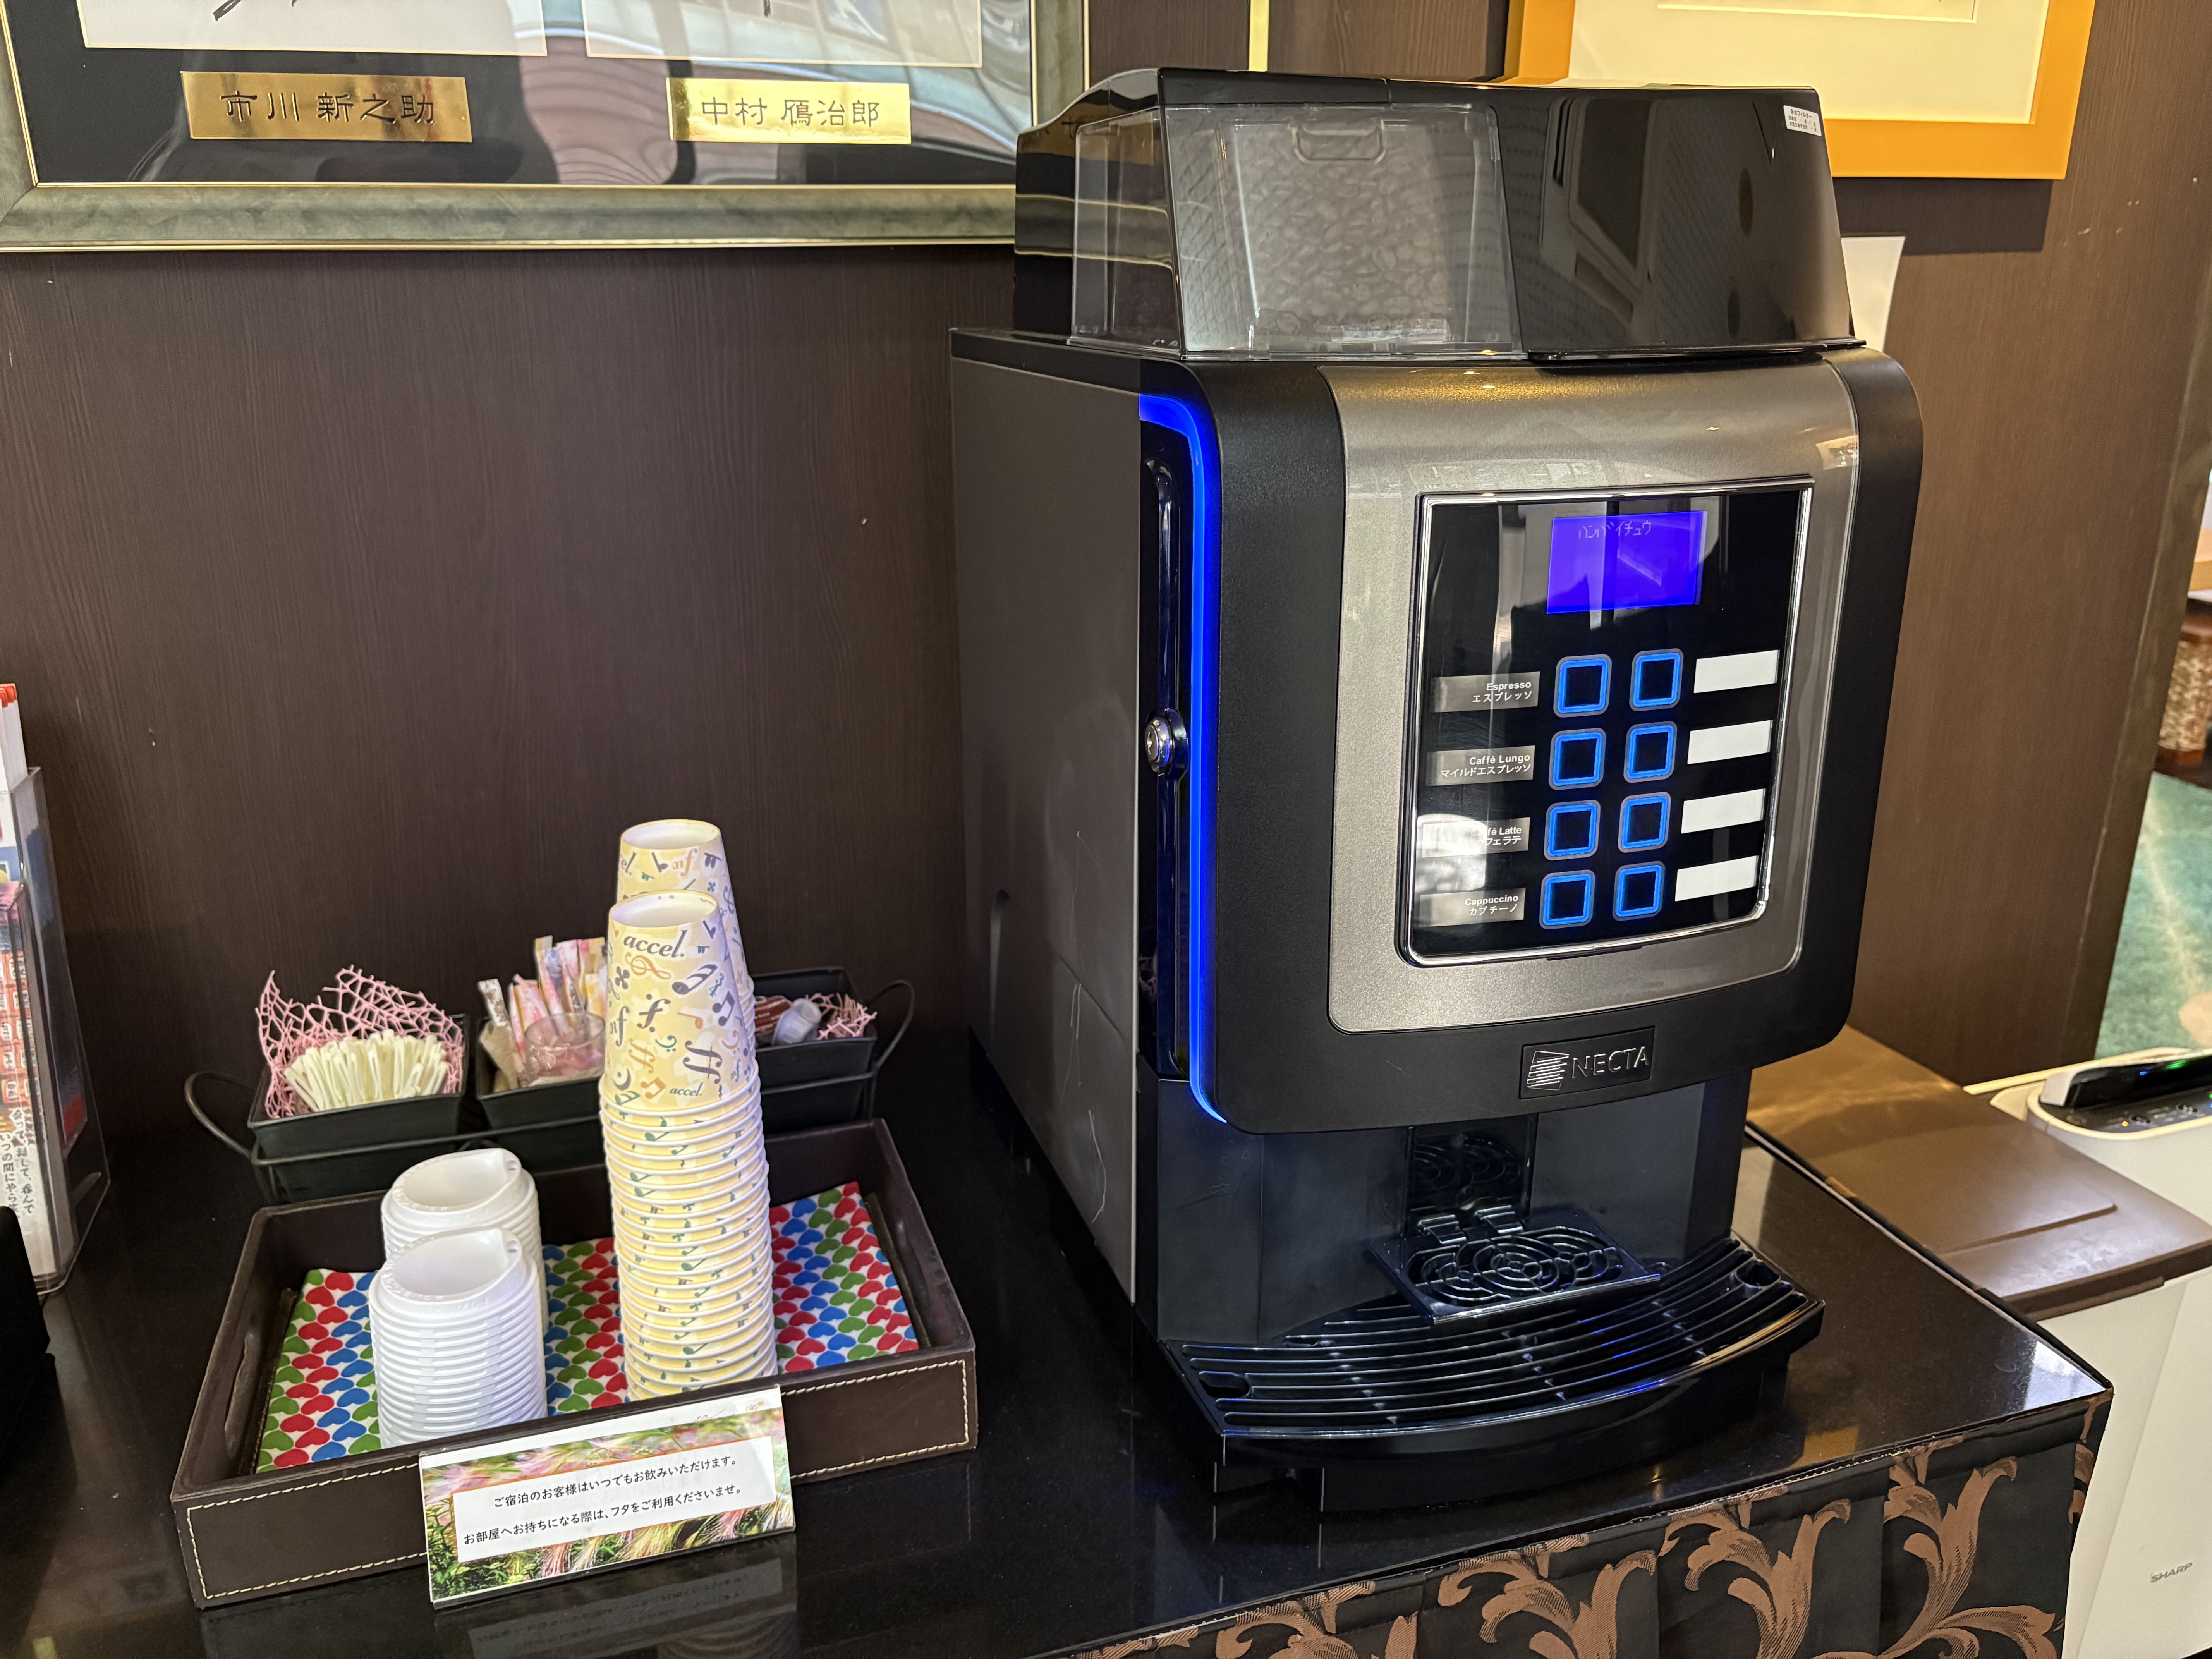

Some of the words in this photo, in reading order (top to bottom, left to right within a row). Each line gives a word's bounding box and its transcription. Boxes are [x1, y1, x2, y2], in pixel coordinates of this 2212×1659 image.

[219, 90, 300, 122] 市川
[316, 92, 435, 124] 新之助
[701, 96, 768, 125] 中村
[1472, 691, 1532, 702] エスプレッソ
[1486, 681, 1532, 692] Espresso
[1469, 756, 1496, 766] Caffé
[1499, 754, 1530, 764] Lungo
[1441, 764, 1531, 778] マイルドエスプレッソ
[1499, 826, 1522, 836] Latte
[1465, 895, 1519, 906] Cappuccino
[623, 929, 688, 958] accel.
[1571, 1046, 1649, 1079] NECTA
[494, 1455, 736, 1507] ご宿泊のお客様はいつでもお飲みいただけます。
[464, 1484, 741, 1545] お部屋へお持ちになる際は、フタをご利用くださいませ。
[2150, 1562, 2193, 1583] SHARP
